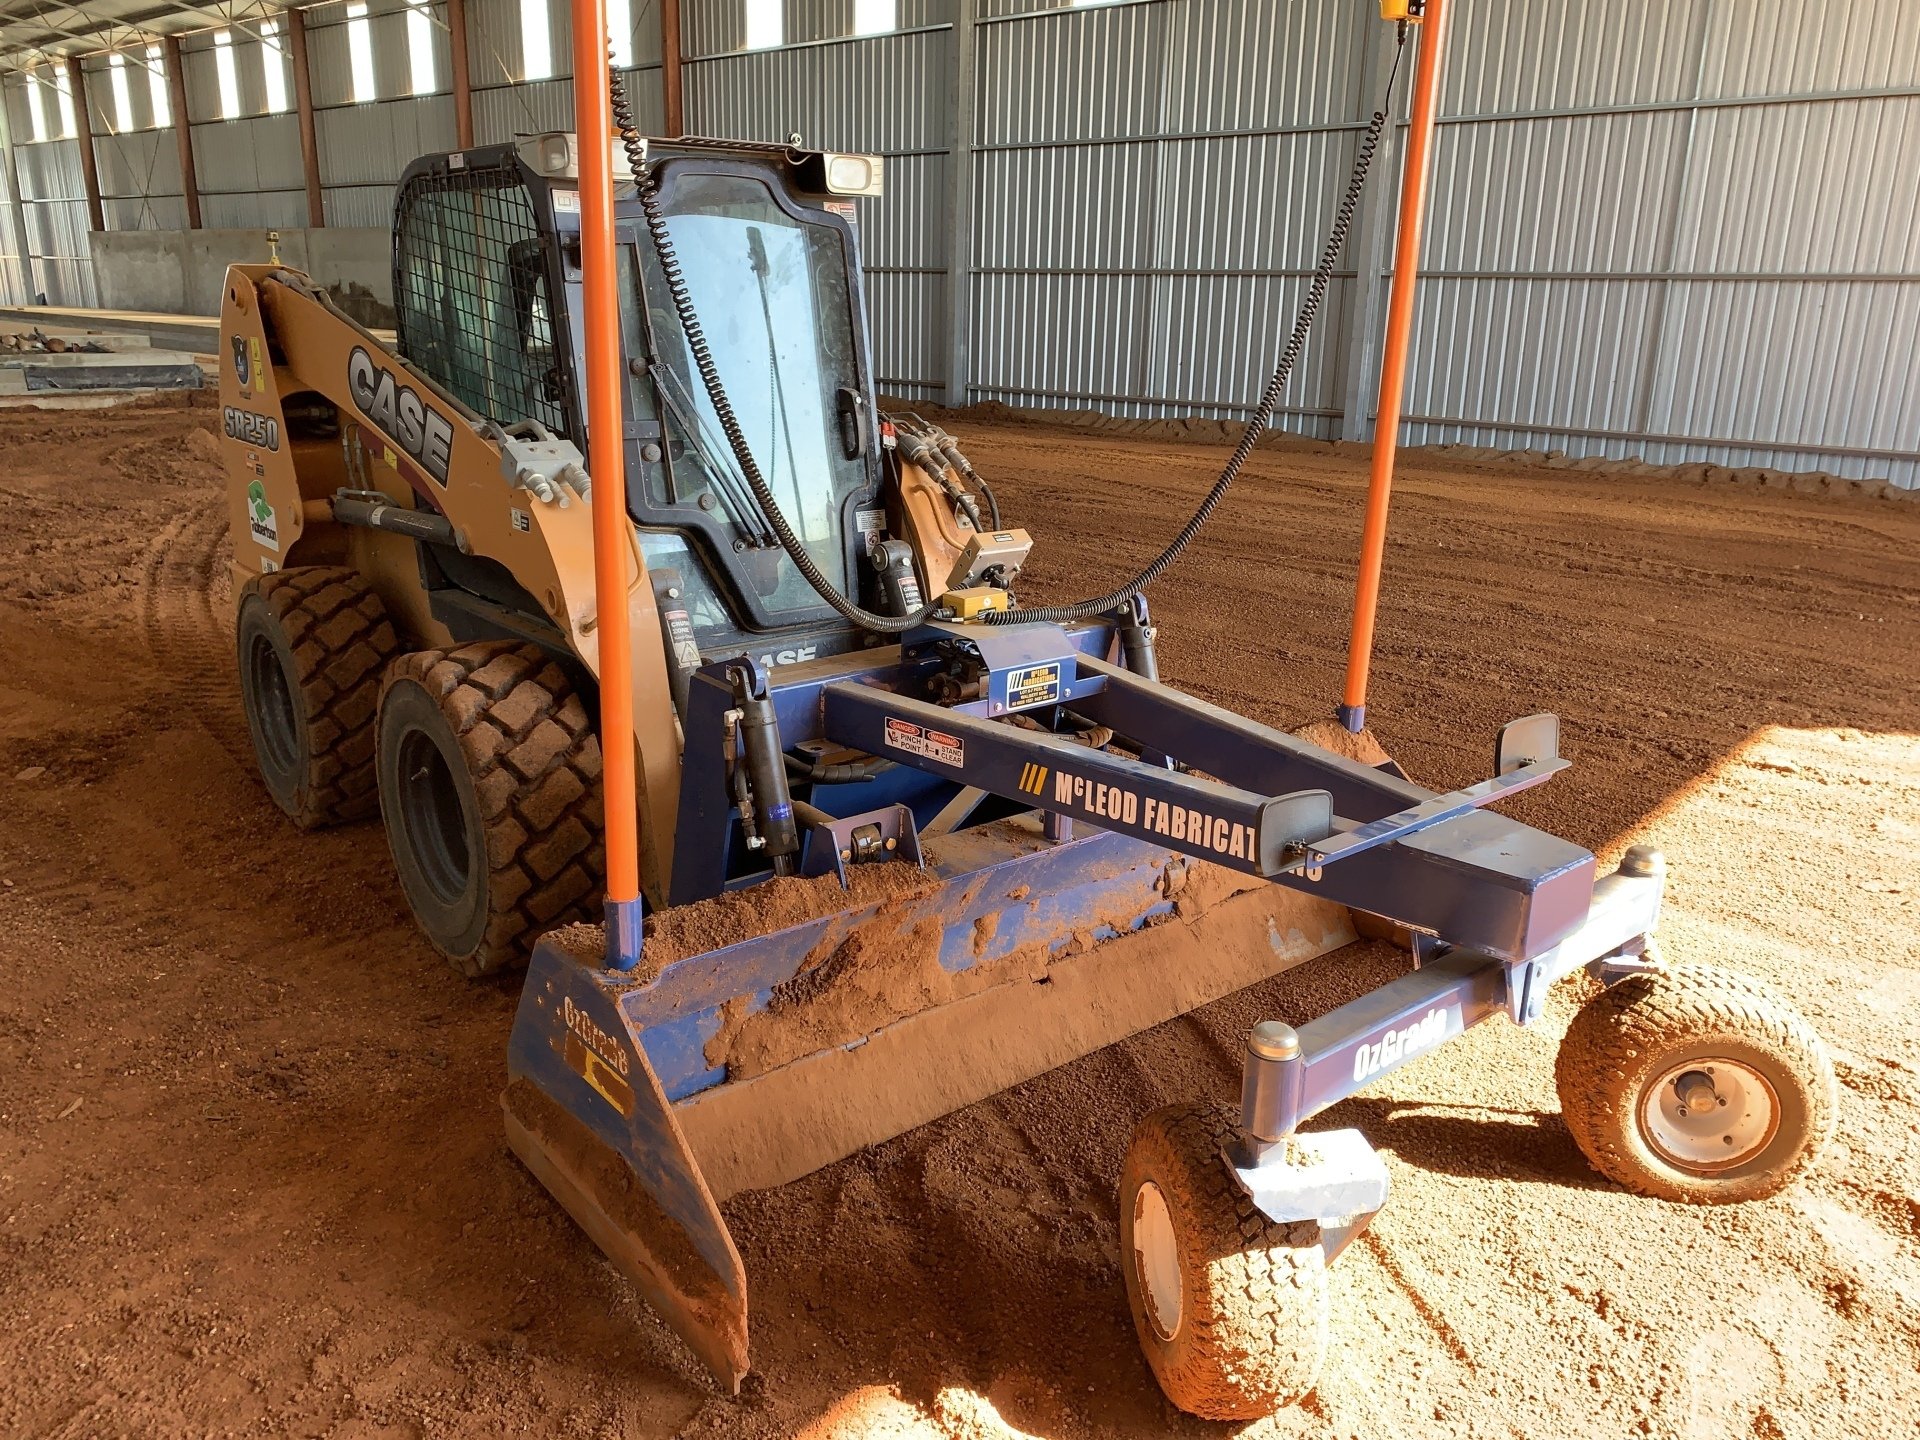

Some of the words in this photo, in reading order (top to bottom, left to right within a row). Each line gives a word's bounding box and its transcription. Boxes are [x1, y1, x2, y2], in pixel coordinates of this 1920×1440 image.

[349, 346, 453, 486] CASE
[224, 405, 279, 452] SR250
[759, 646, 817, 668] ASE
[892, 721, 917, 734] DANGER
[901, 733, 922, 746] PINCH
[930, 732, 957, 747] WARNING
[901, 741, 921, 753] POINT
[941, 746, 962, 757] STAND
[941, 753, 962, 764] CLEAR
[1353, 1008, 1448, 1083] OzGrade
